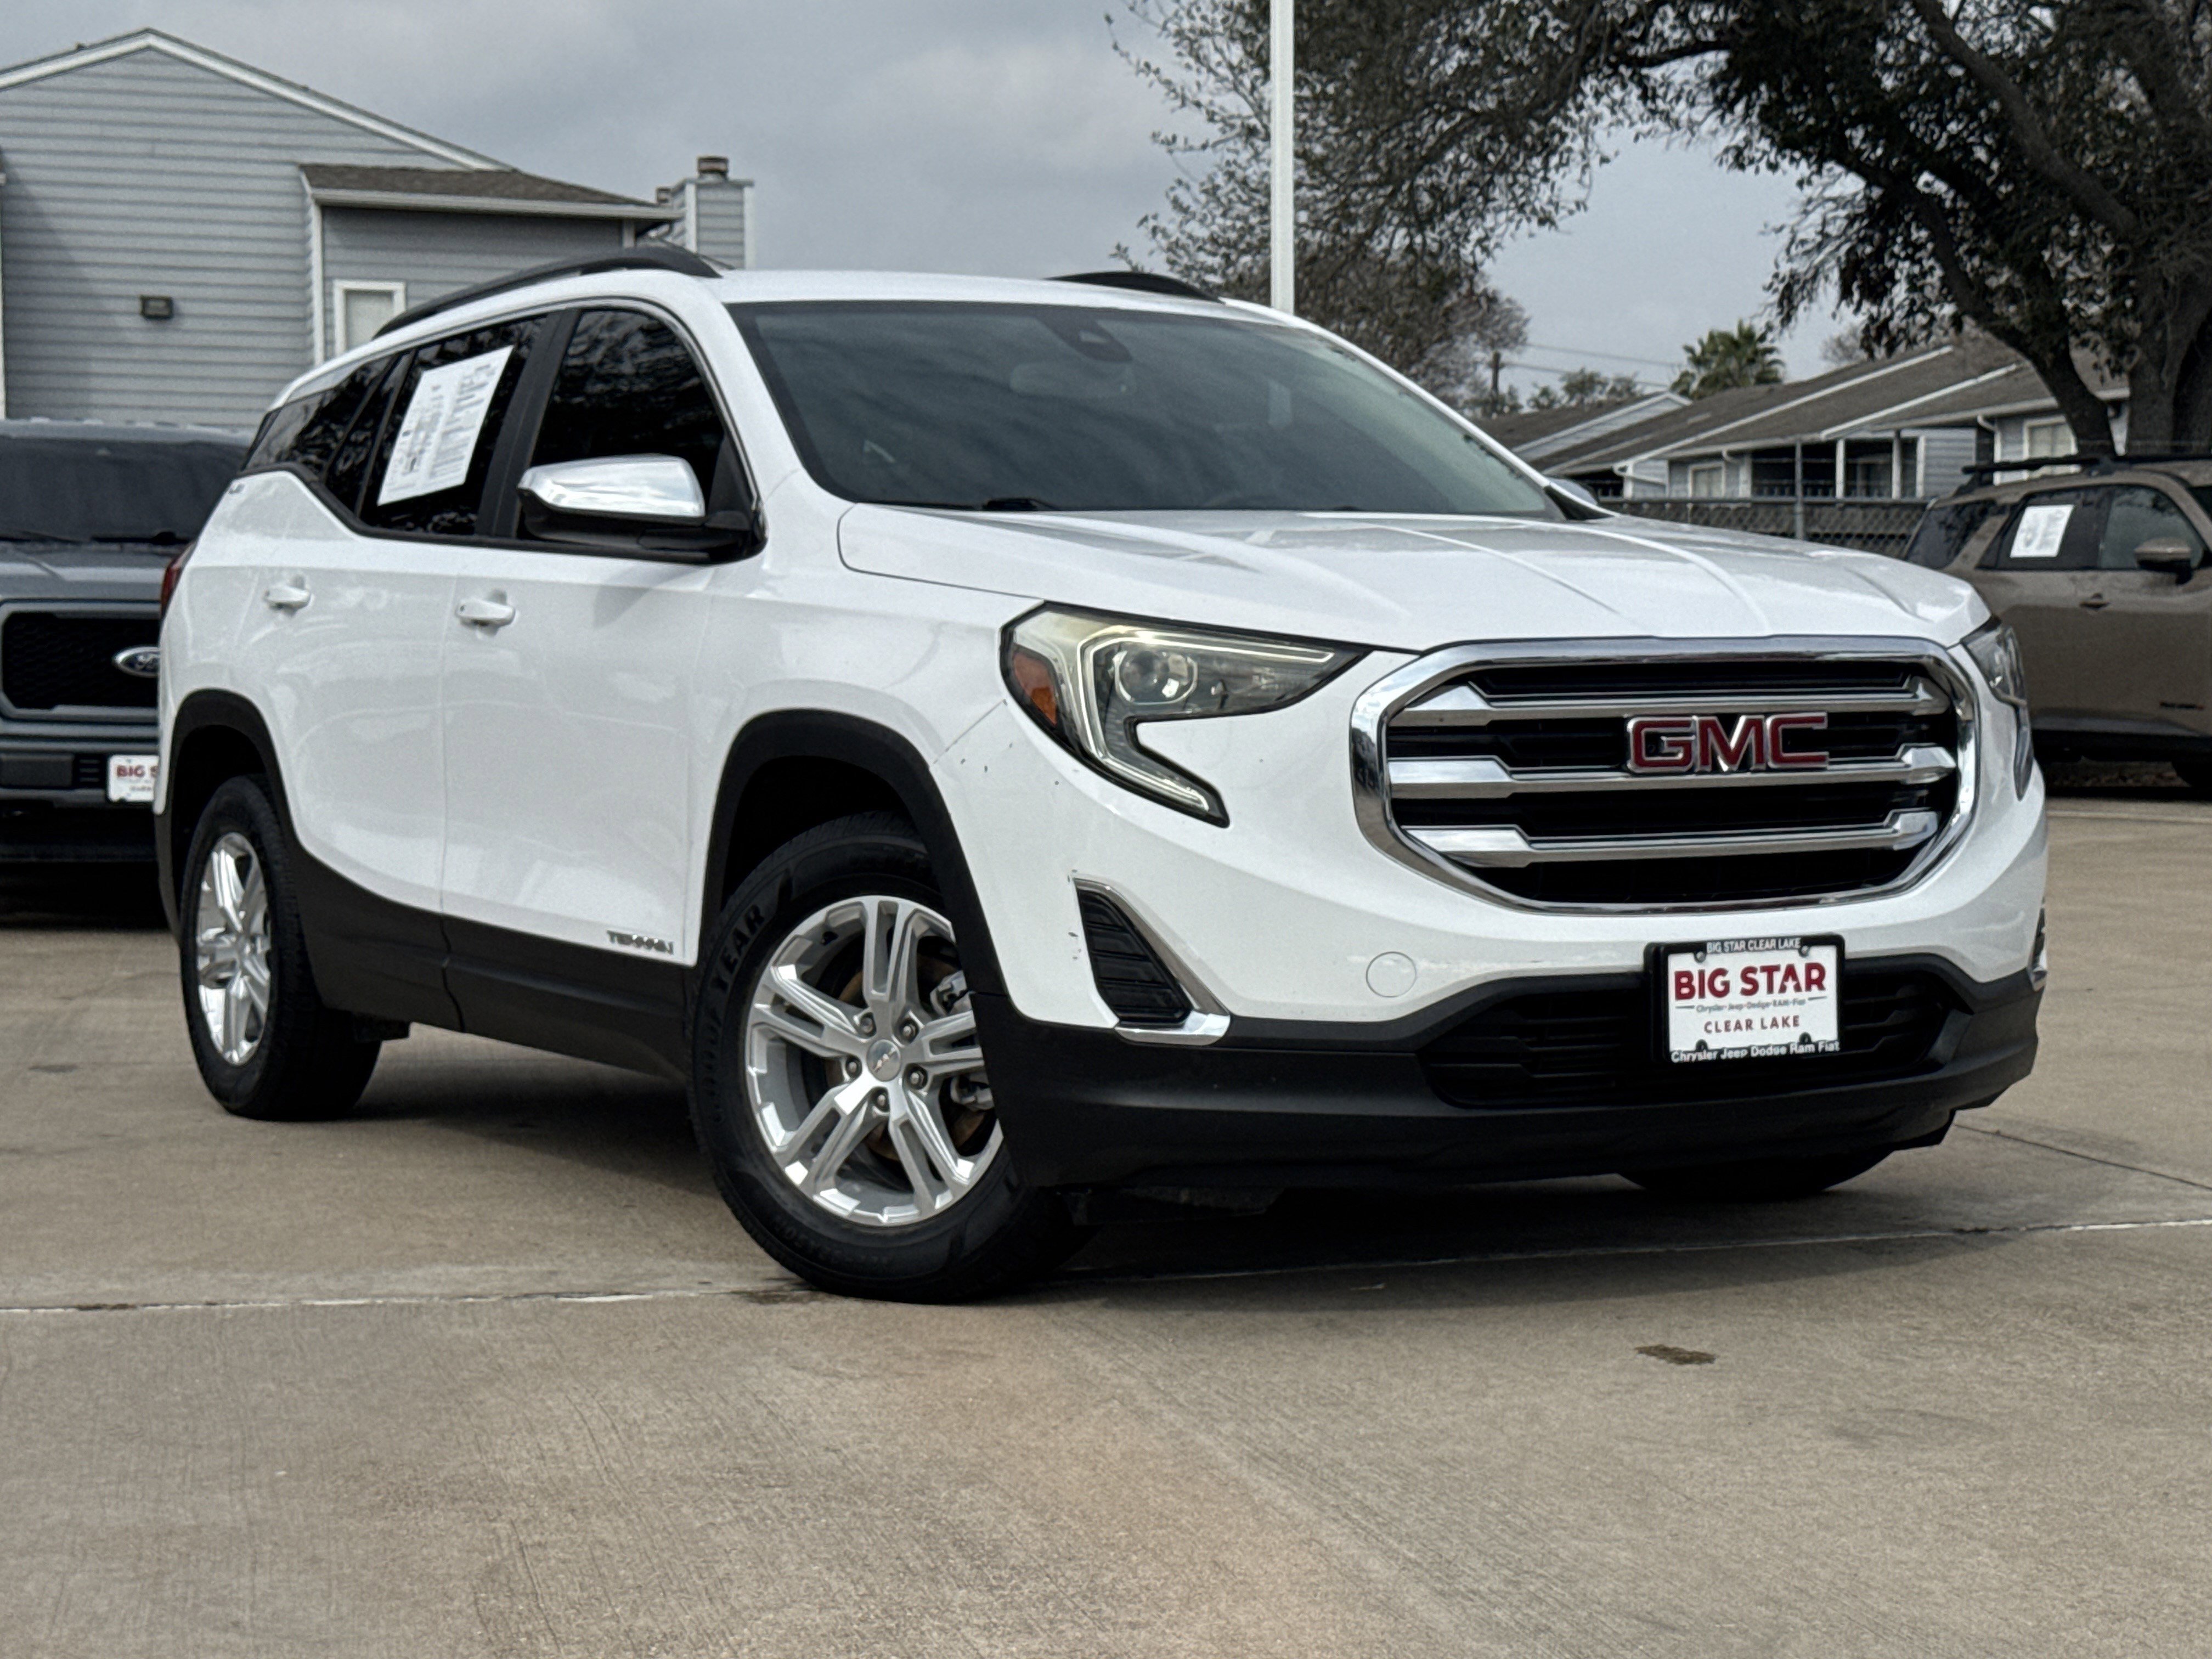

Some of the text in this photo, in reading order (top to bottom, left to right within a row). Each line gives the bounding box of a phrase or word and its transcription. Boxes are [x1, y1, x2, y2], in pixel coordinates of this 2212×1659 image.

[1627, 712, 1829, 773] GMC
[116, 765, 145, 778] BIG
[1707, 938, 1801, 953] BIG STAR CLEAR LAKE
[1674, 962, 1826, 1001] BIG STAR
[1704, 1015, 1800, 1034] CLEAR LAKE
[1671, 1041, 1839, 1063] Chrysler Jeep Dodge Ram Fiat
